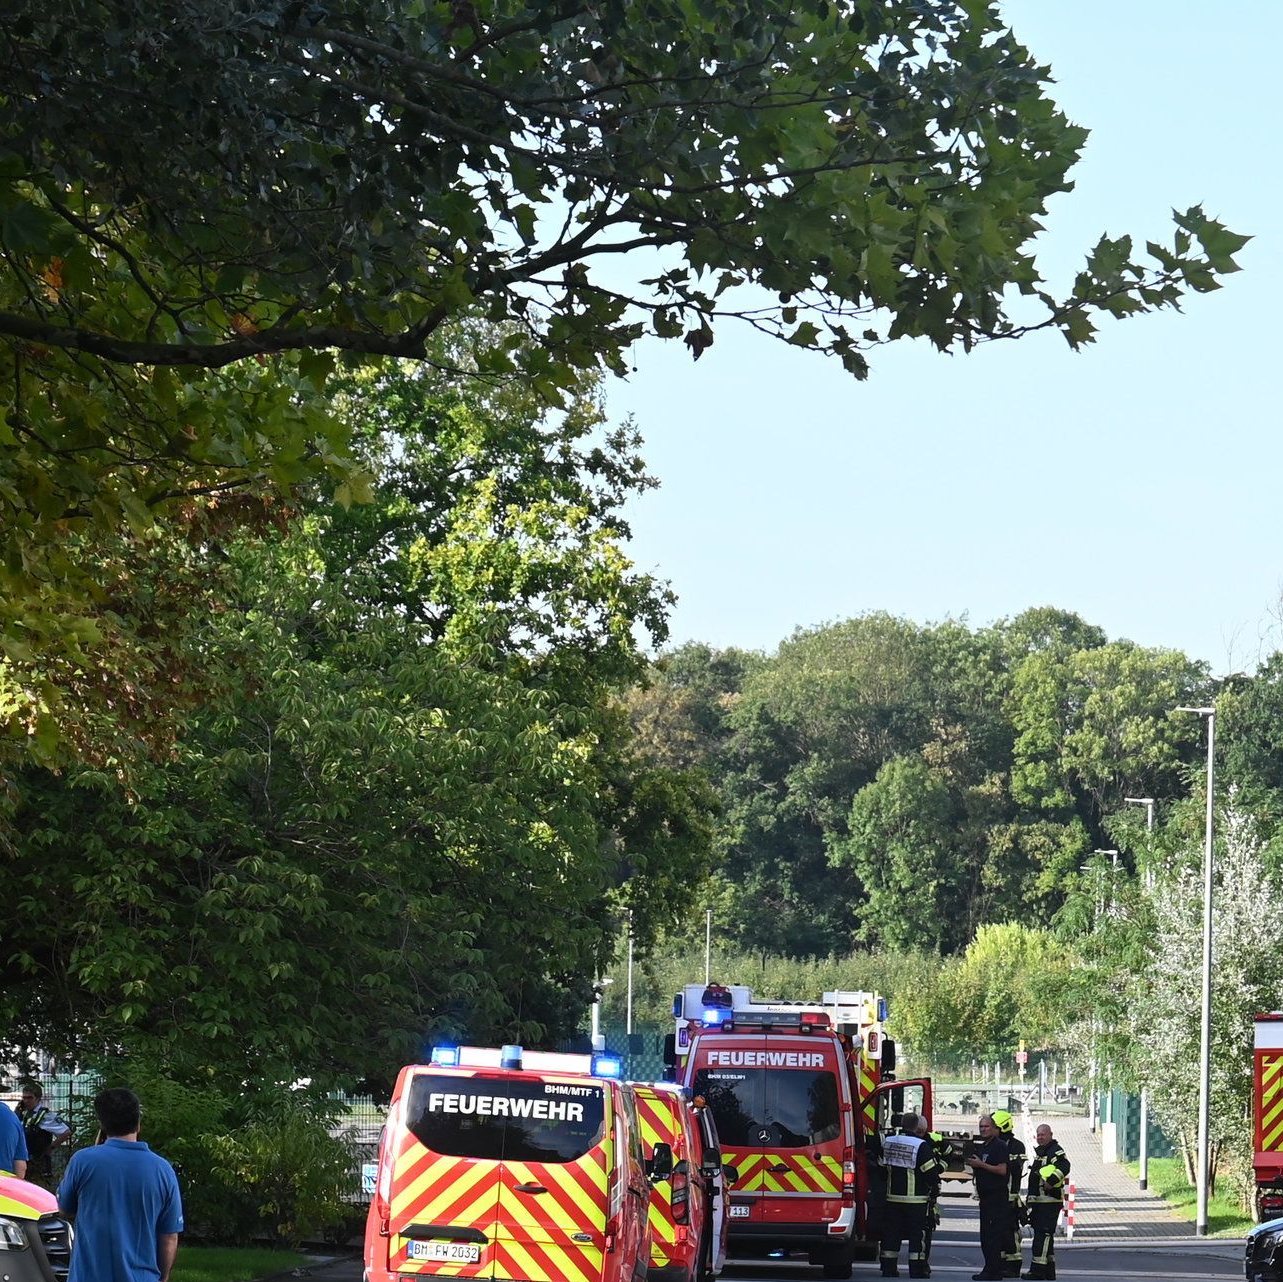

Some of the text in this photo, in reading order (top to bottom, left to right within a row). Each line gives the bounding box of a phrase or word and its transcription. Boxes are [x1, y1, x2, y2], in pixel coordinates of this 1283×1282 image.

[707, 1051, 825, 1067] FEUERWEHR
[544, 1084, 593, 1097] BHM/MTF
[428, 1093, 585, 1122] FEUERWEHR
[414, 1243, 478, 1259] BM FW 2032
